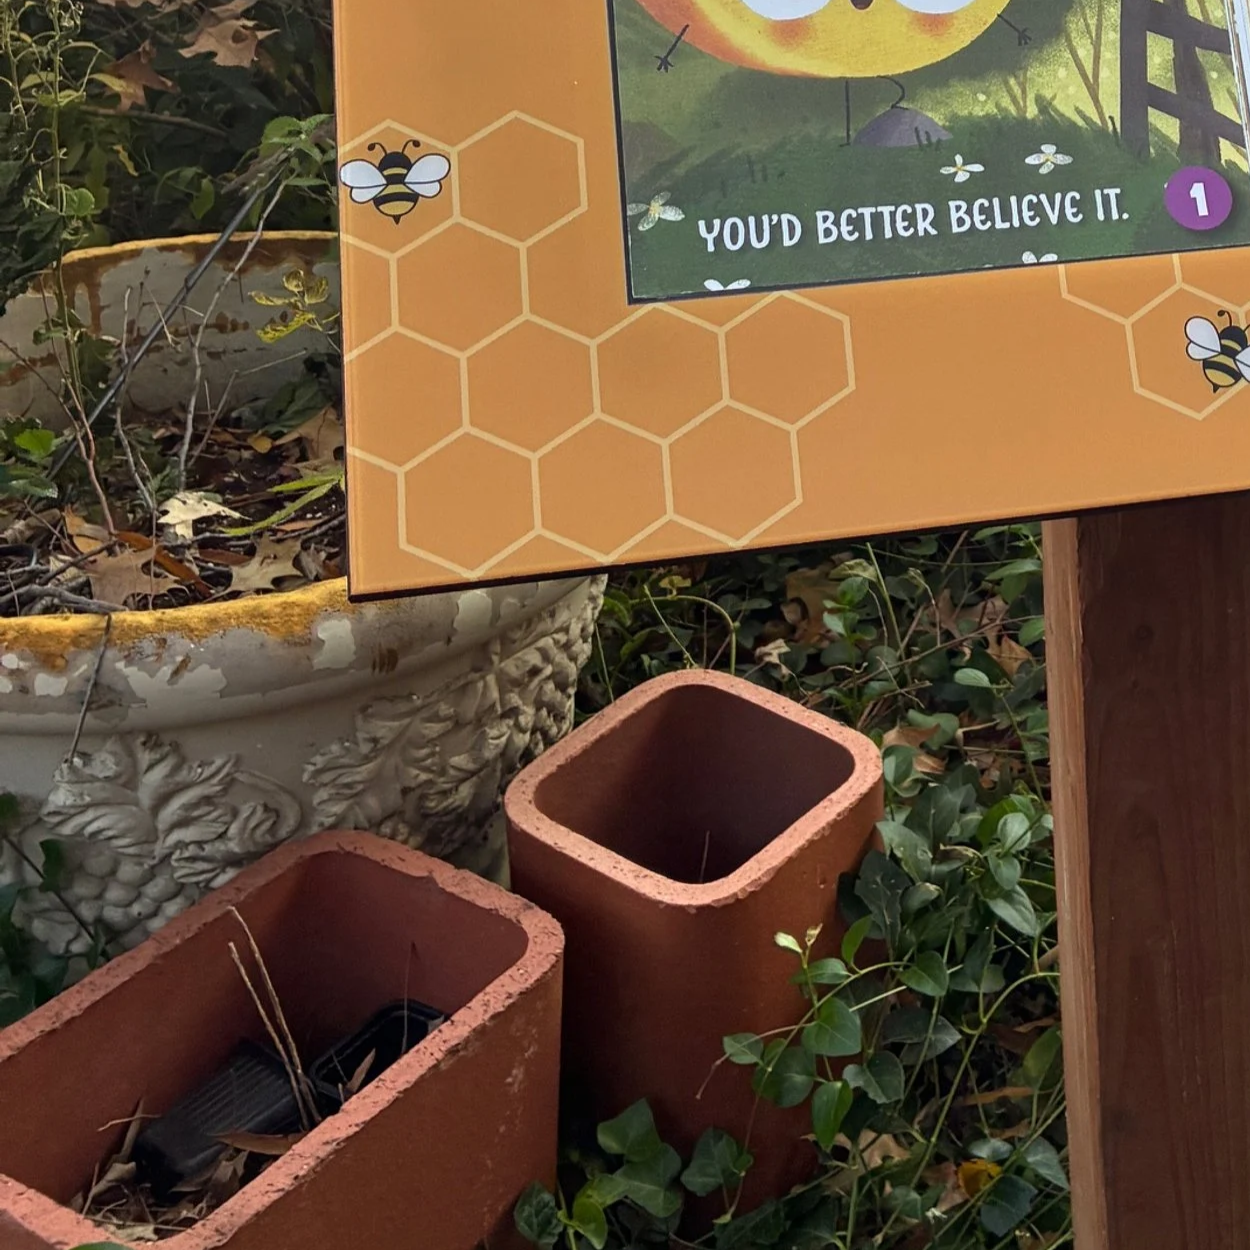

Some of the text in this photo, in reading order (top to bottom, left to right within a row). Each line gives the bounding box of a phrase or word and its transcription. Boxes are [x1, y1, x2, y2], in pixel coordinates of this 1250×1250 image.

[815, 202, 938, 245] BETTER
[950, 190, 1083, 233] BELIEVE
[1094, 187, 1130, 223] IT.
[1188, 181, 1210, 217] 1
